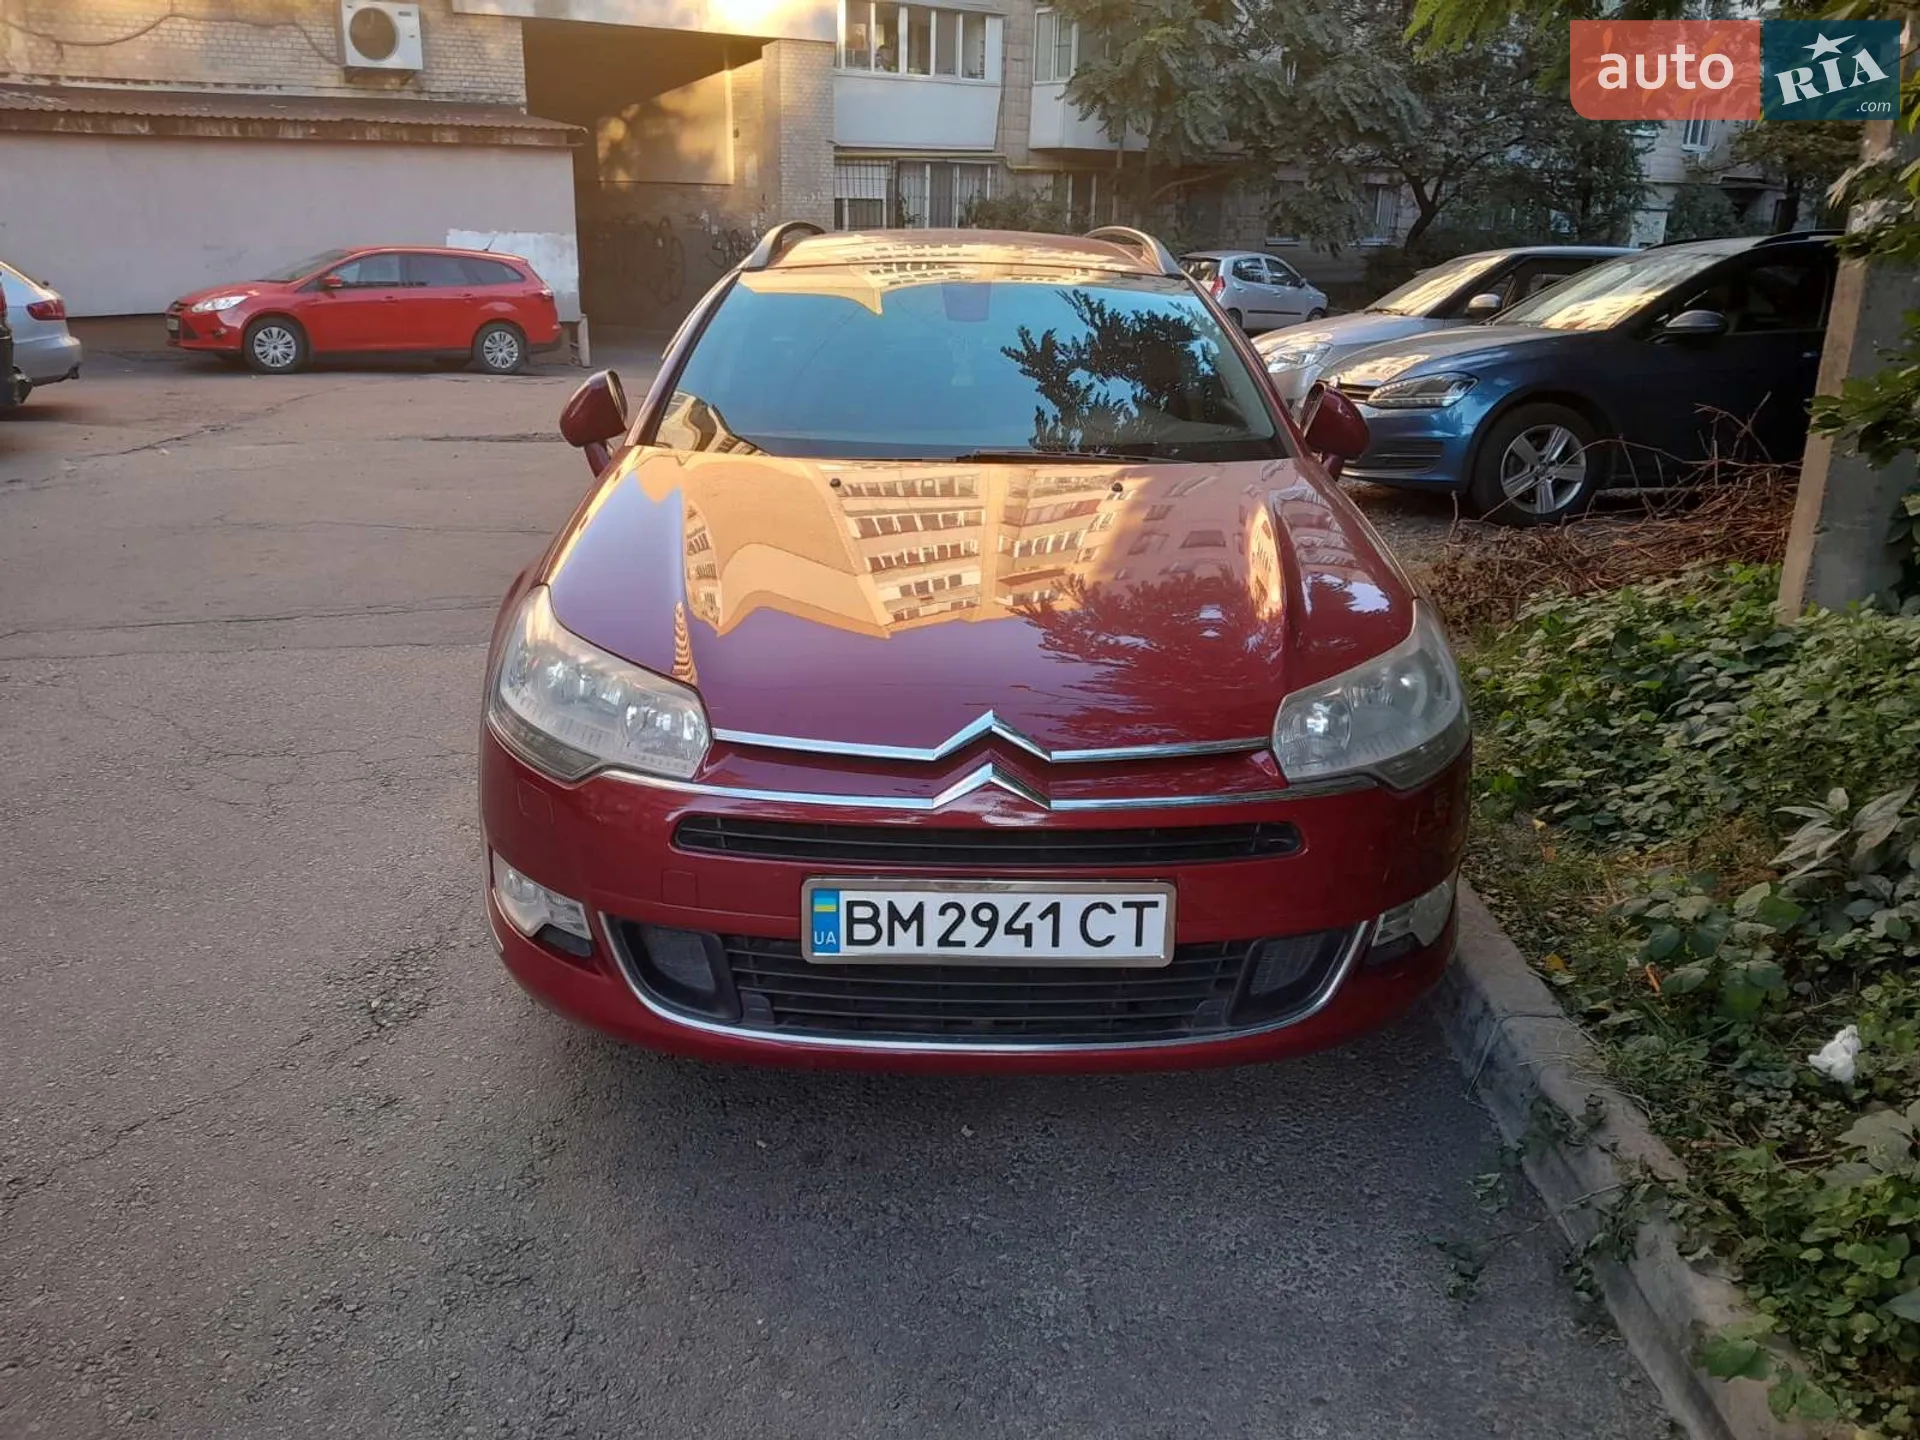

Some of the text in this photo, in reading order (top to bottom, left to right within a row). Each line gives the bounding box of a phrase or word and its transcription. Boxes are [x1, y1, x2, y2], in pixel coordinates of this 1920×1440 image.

[813, 931, 837, 946] UA
[846, 901, 1159, 948] BM 2941 CT
